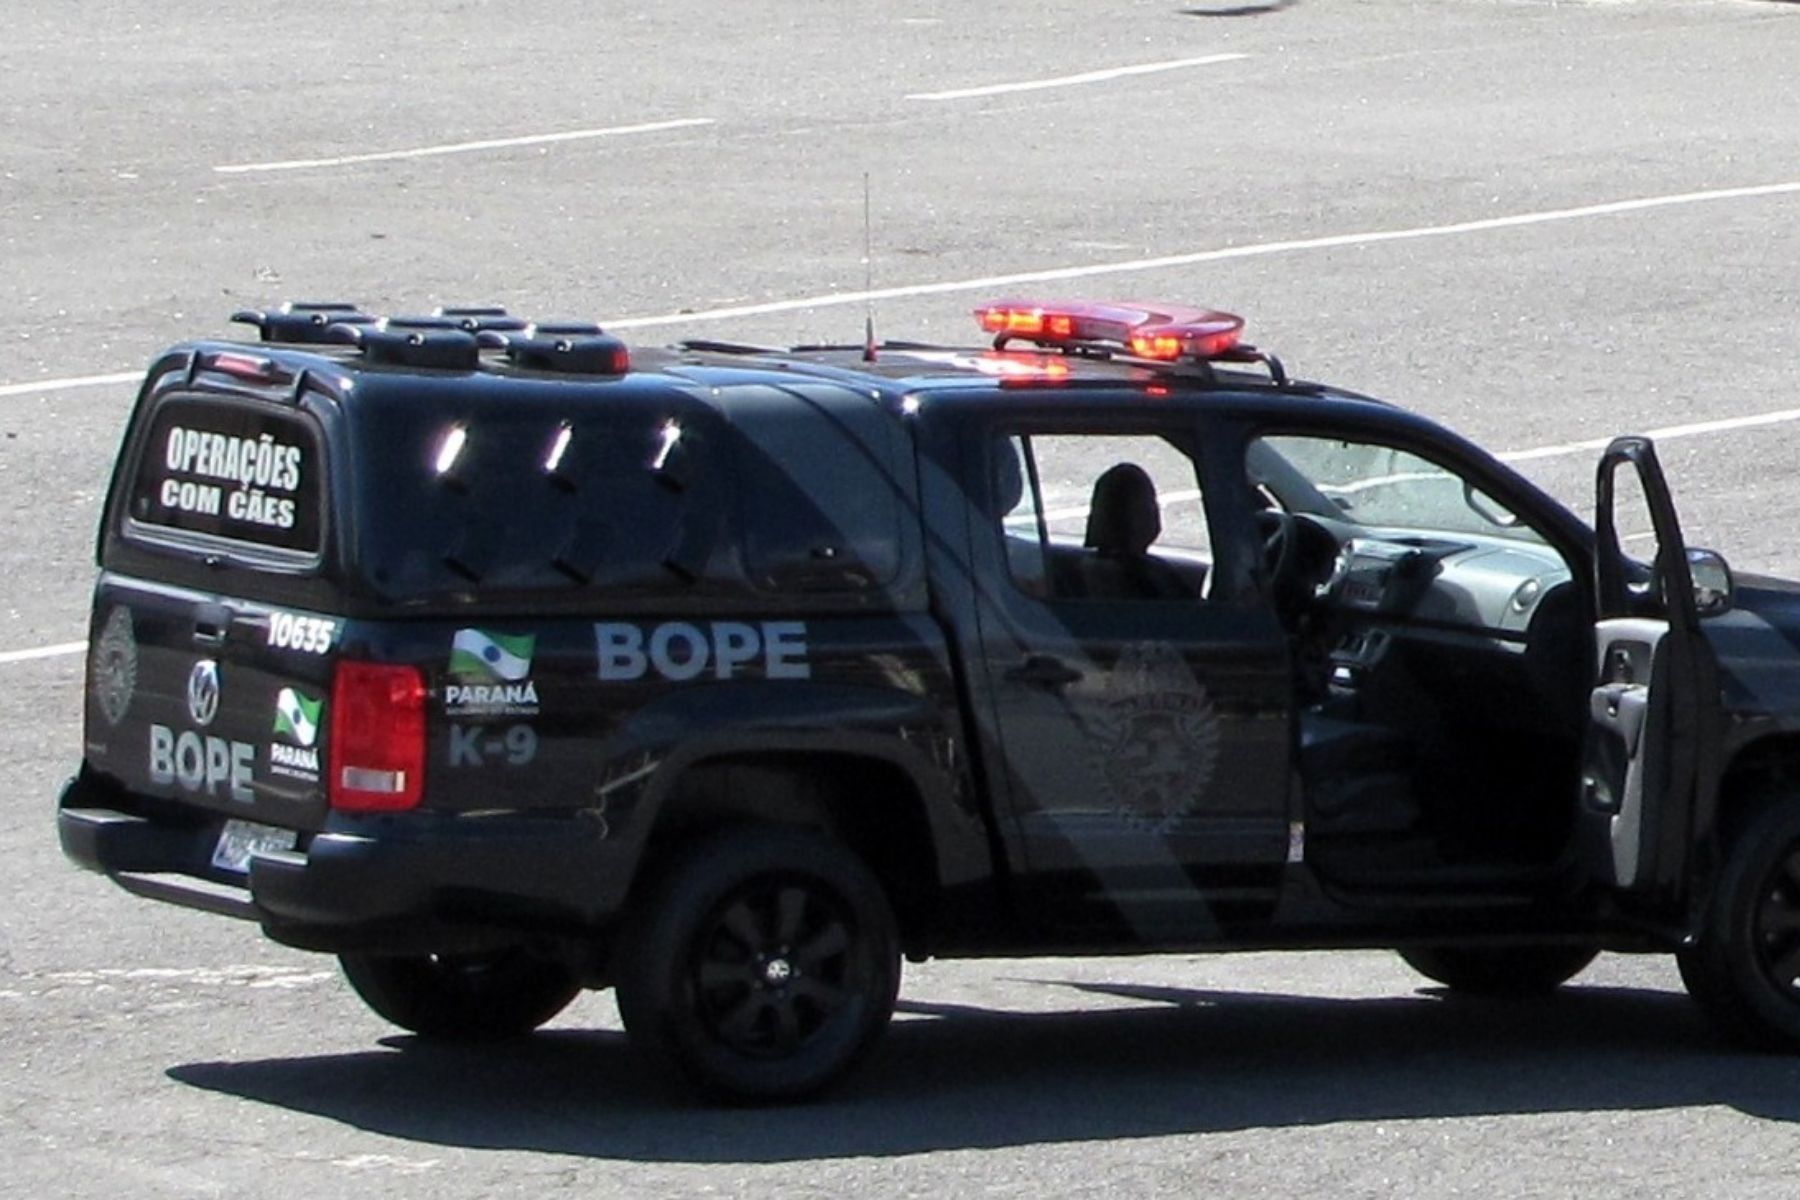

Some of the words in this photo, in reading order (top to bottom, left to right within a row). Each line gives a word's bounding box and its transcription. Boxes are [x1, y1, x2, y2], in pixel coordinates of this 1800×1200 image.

[166, 426, 301, 491] OPERAÇÕES
[161, 479, 222, 515] COM
[228, 488, 296, 528] CÃES
[268, 611, 336, 654] 10635
[594, 621, 811, 681] BOPE
[445, 680, 539, 704] PARANÁ
[151, 723, 256, 804] BOPE
[449, 723, 539, 767] K-9
